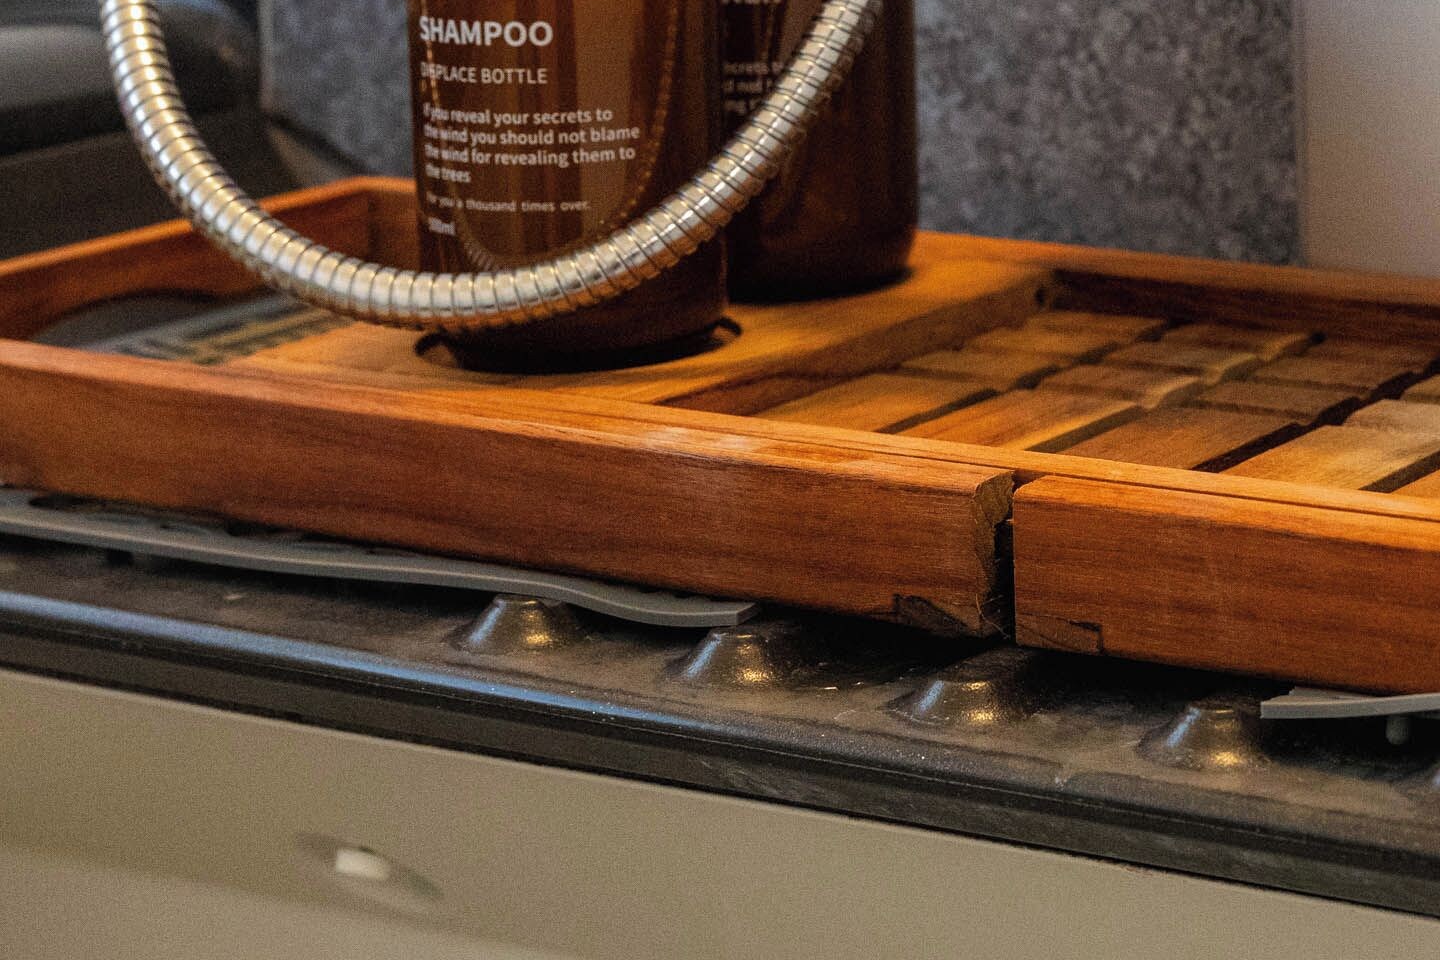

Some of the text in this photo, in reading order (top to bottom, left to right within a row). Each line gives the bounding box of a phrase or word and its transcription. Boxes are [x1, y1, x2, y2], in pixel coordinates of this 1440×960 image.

[419, 15, 553, 47] SHAMPOO
[480, 67, 548, 84] BOTTLE
[450, 109, 490, 124] reveal
[493, 113, 529, 128] your
[533, 109, 592, 125] secrets
[596, 108, 613, 122] to
[470, 132, 497, 147] you
[500, 129, 554, 145] should
[558, 130, 587, 144] not
[590, 126, 640, 143] blame
[471, 148, 491, 164] for
[495, 149, 569, 168] revealing
[572, 148, 616, 164] them
[619, 147, 636, 160] to
[466, 199, 517, 212] thousand
[521, 200, 556, 212] times
